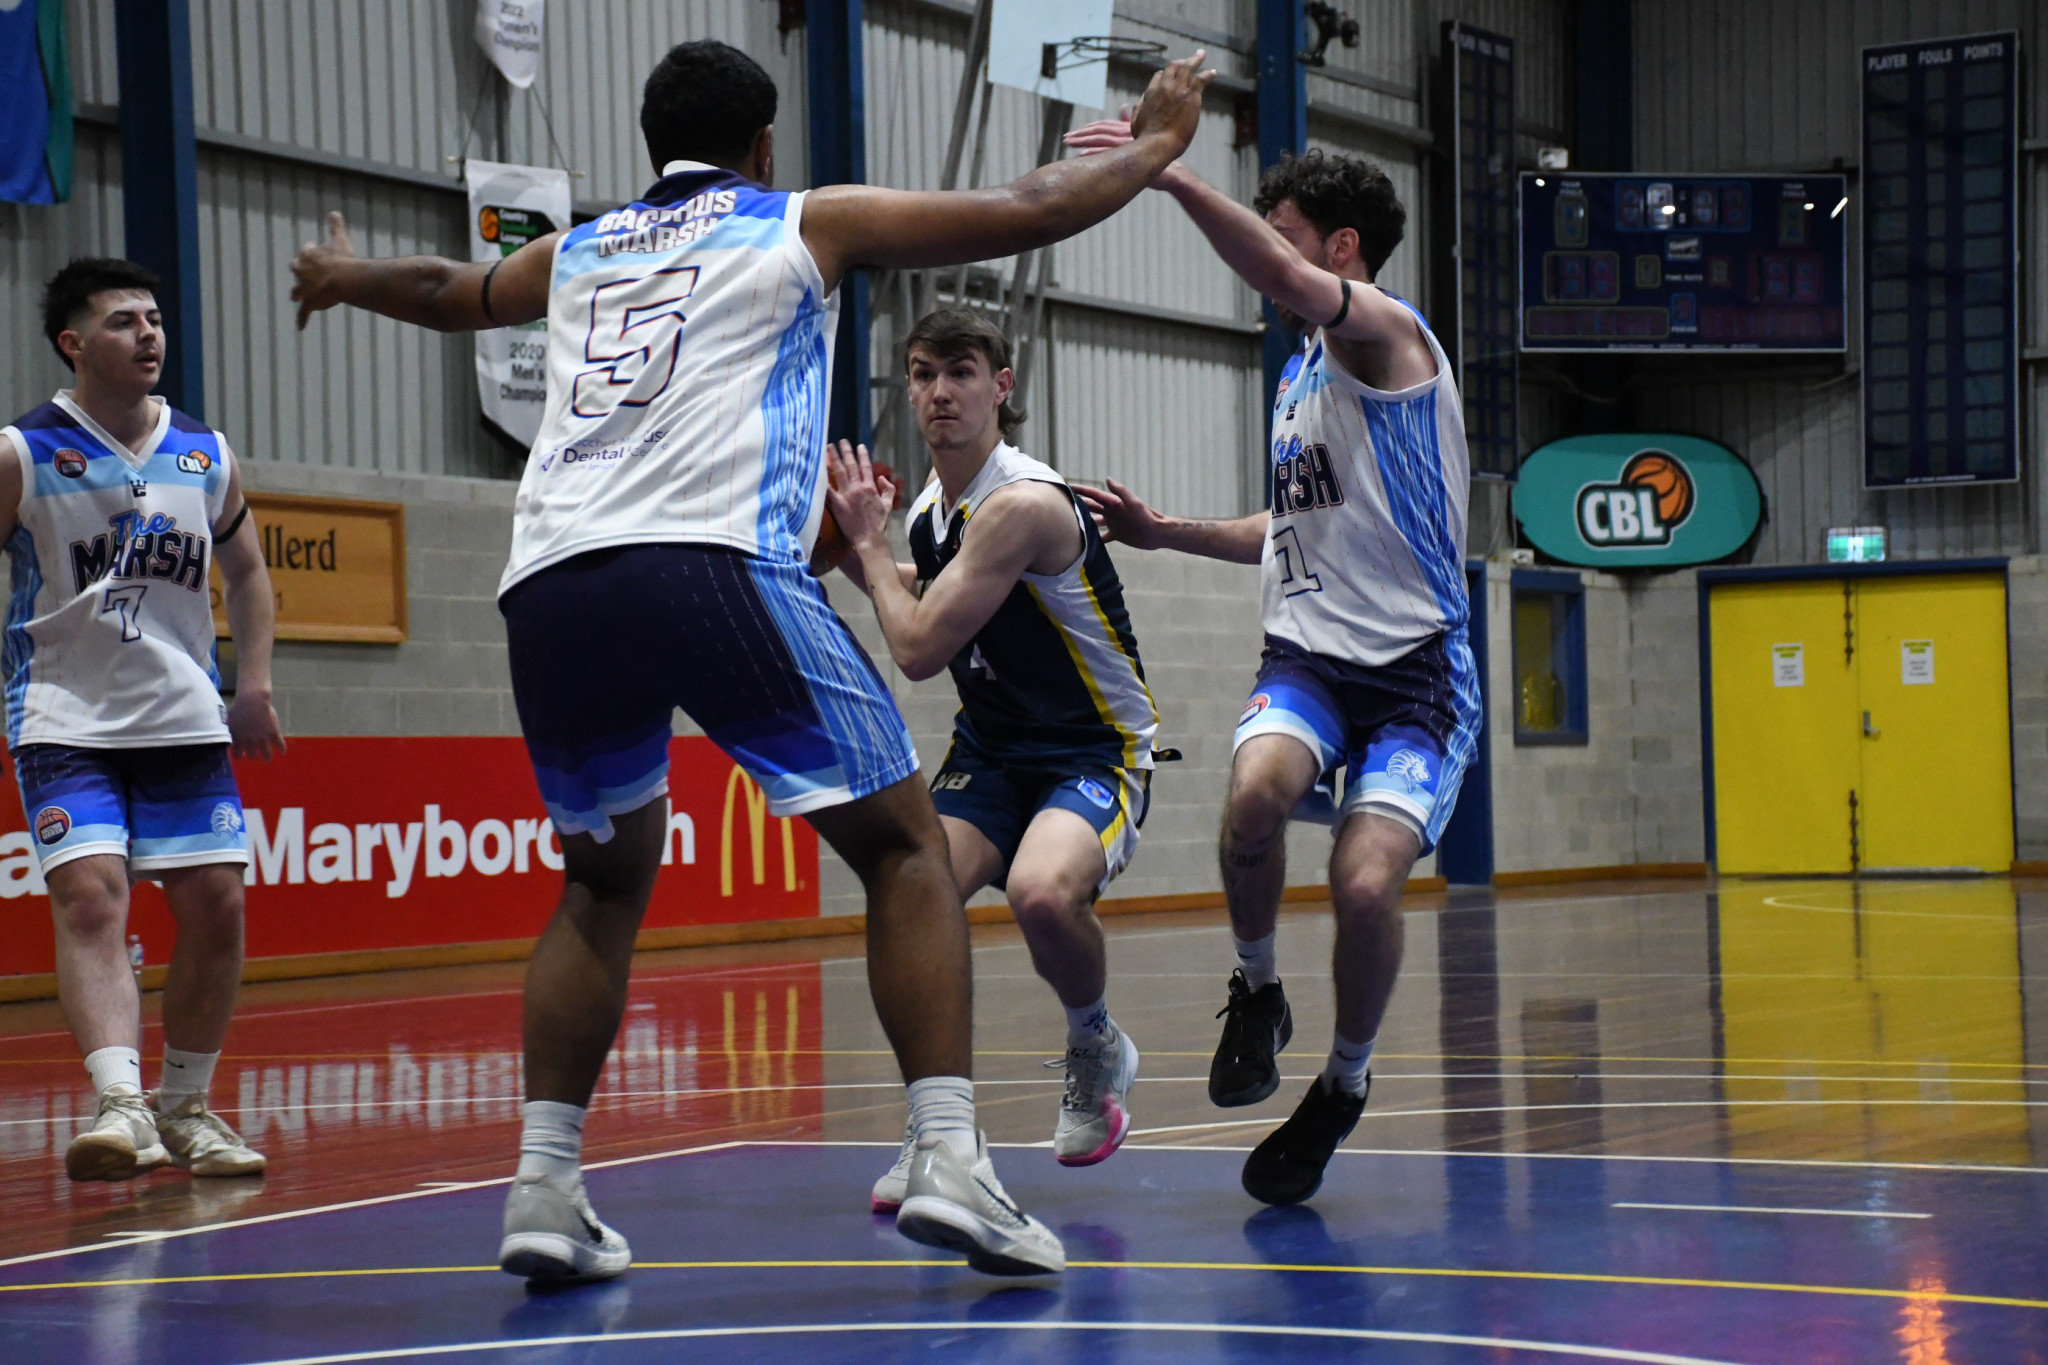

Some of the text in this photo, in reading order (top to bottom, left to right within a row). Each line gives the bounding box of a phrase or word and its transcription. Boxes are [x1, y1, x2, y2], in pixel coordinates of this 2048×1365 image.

[1867, 42, 2003, 71] PLAYER FOULS POINTS
[598, 217, 719, 258] MARSH
[509, 342, 545, 360] 2020
[571, 265, 701, 418] 5
[501, 383, 546, 404] Champio
[512, 362, 544, 382] Men's
[178, 454, 205, 473] CBL
[562, 446, 625, 463] Dental
[1272, 444, 1344, 519] RSH
[109, 508, 175, 545] The
[1584, 490, 1664, 540] CBL
[70, 527, 207, 595] MARSH
[264, 524, 337, 571] llerd
[1272, 525, 1323, 598] 1
[102, 585, 148, 643] 7
[240, 798, 696, 898] Maryboroh
